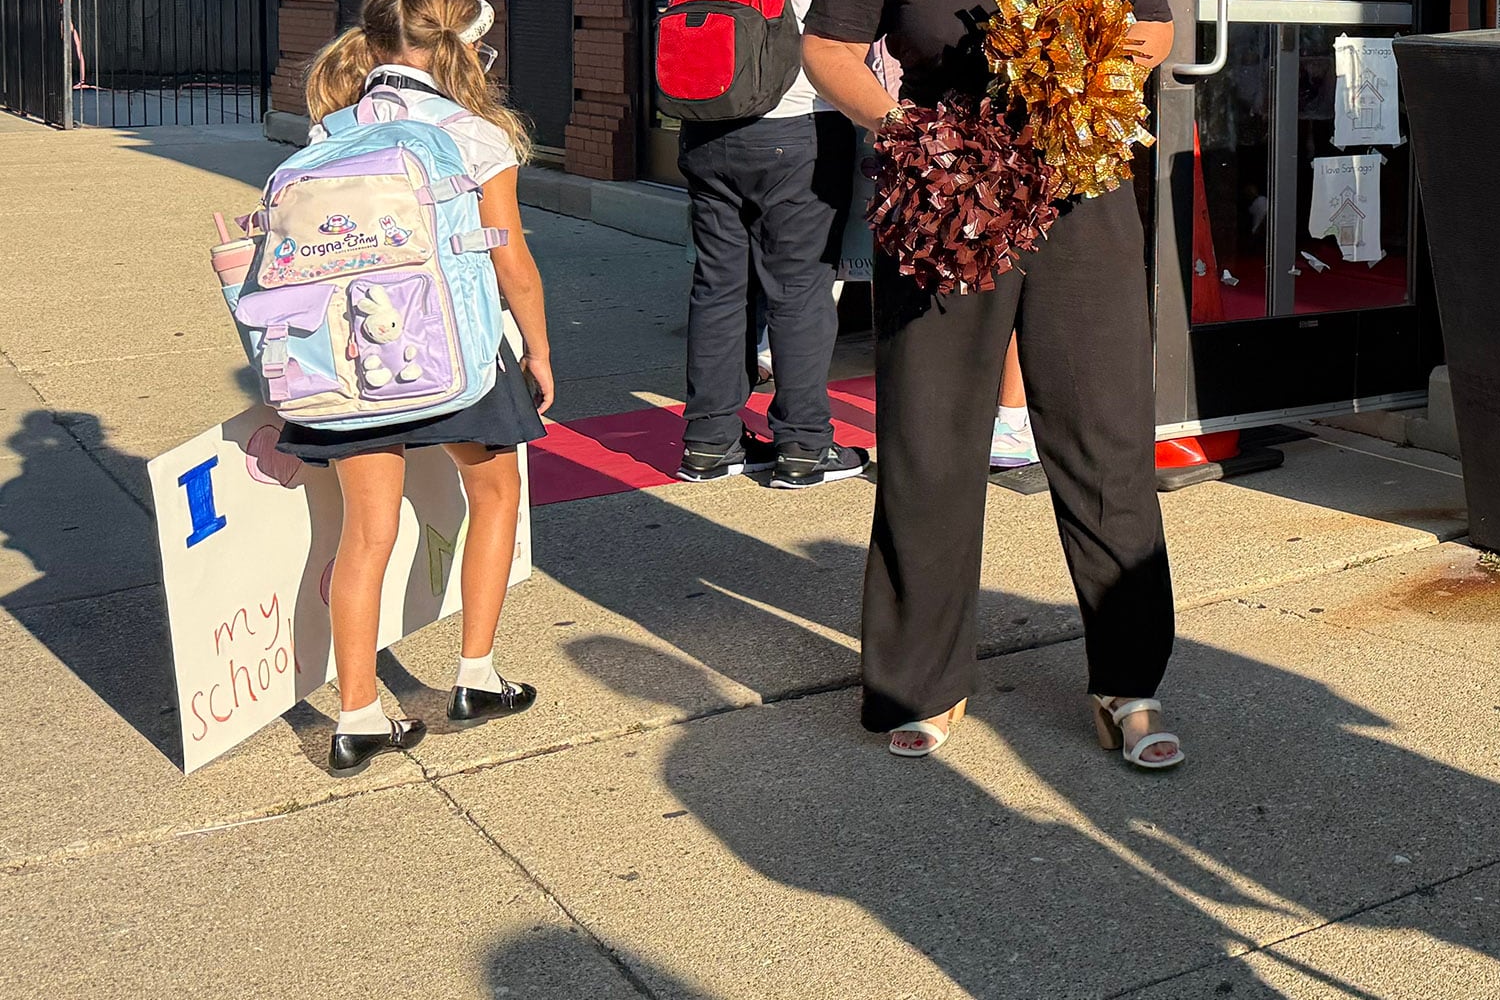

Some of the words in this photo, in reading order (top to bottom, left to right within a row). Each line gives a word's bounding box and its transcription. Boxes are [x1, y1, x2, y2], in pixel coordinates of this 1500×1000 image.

[1326, 164, 1340, 175] love
[177, 454, 227, 549] I
[214, 592, 280, 657] my
[191, 617, 301, 742] school
